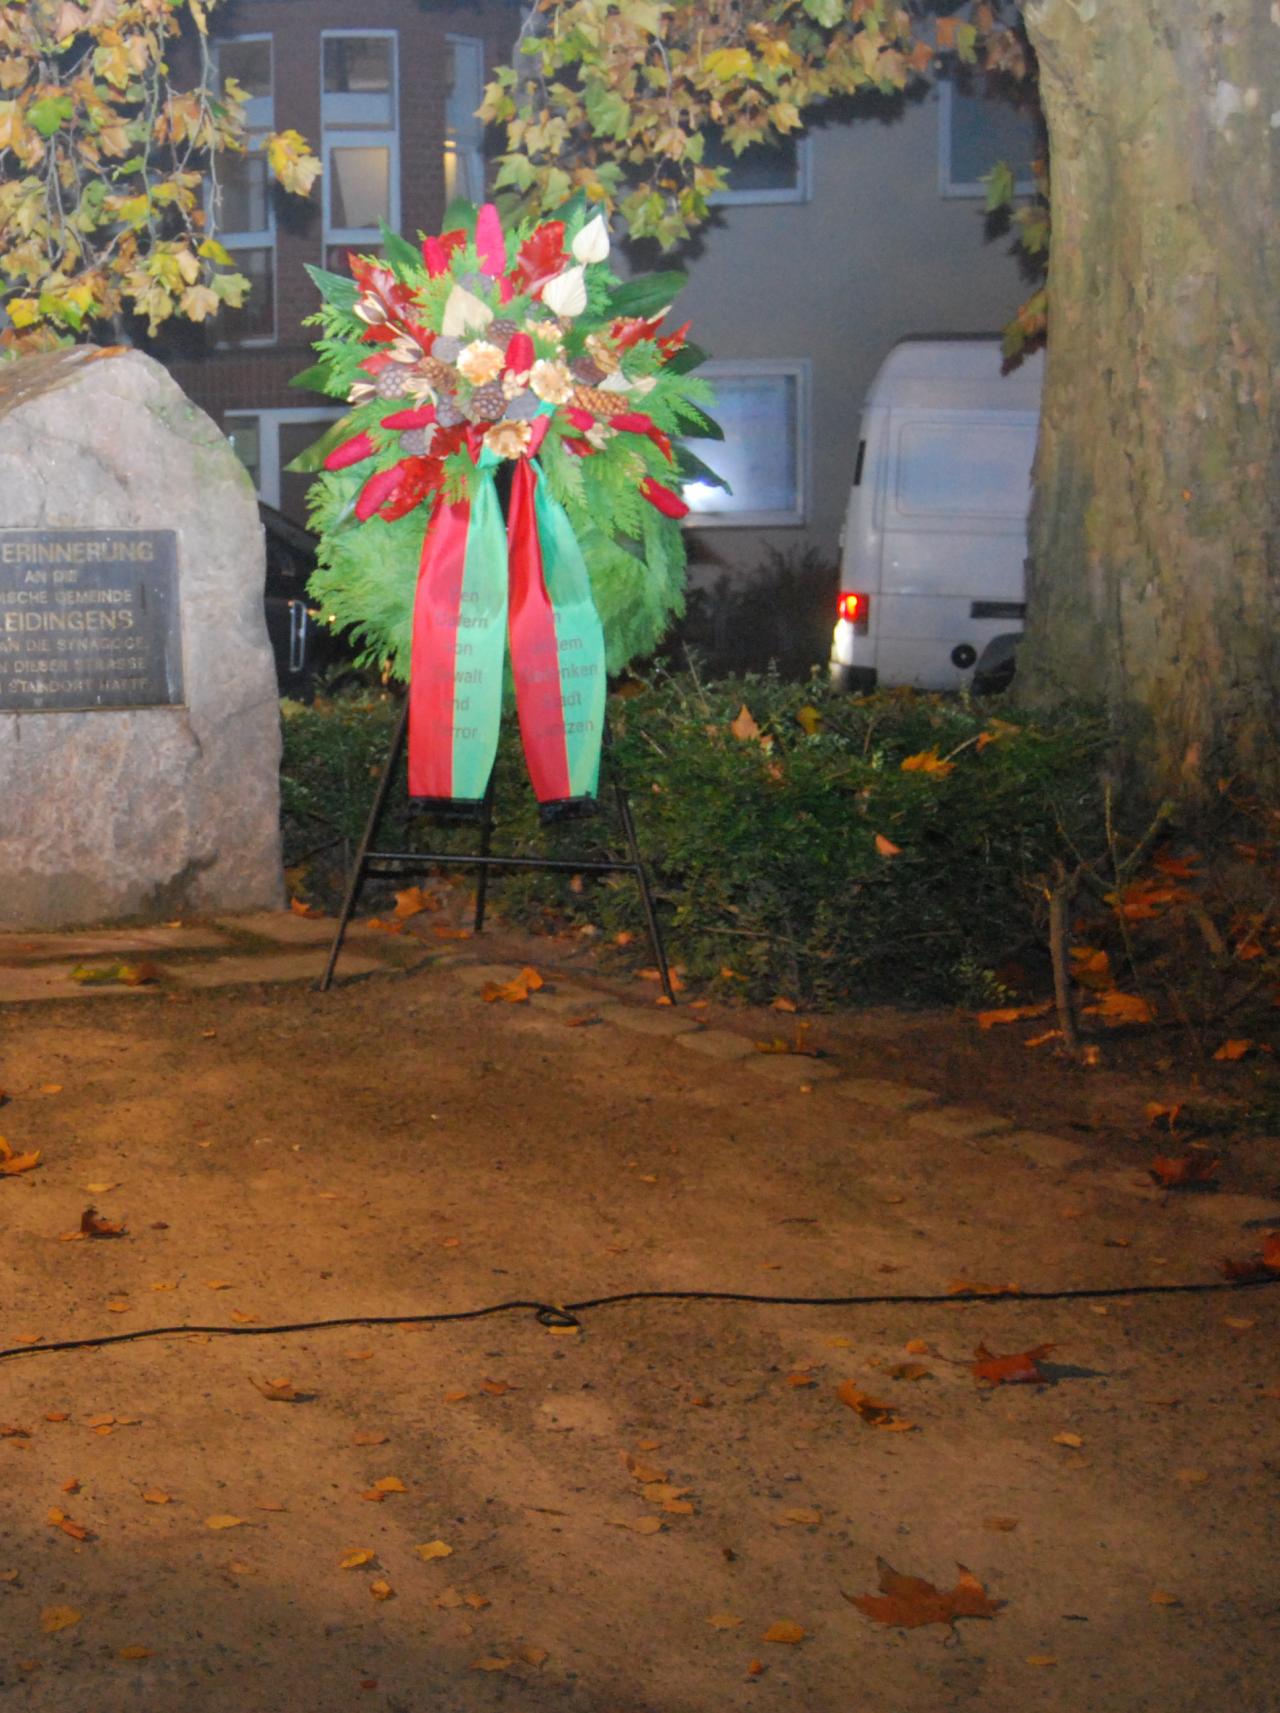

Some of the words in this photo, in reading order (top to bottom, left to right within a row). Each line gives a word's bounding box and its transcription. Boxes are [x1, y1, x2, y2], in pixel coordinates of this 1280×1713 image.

[2, 541, 154, 563] ERINNERUNG
[25, 570, 47, 584] AN
[53, 569, 78, 583] DIE
[55, 589, 132, 604] GEMEINDE
